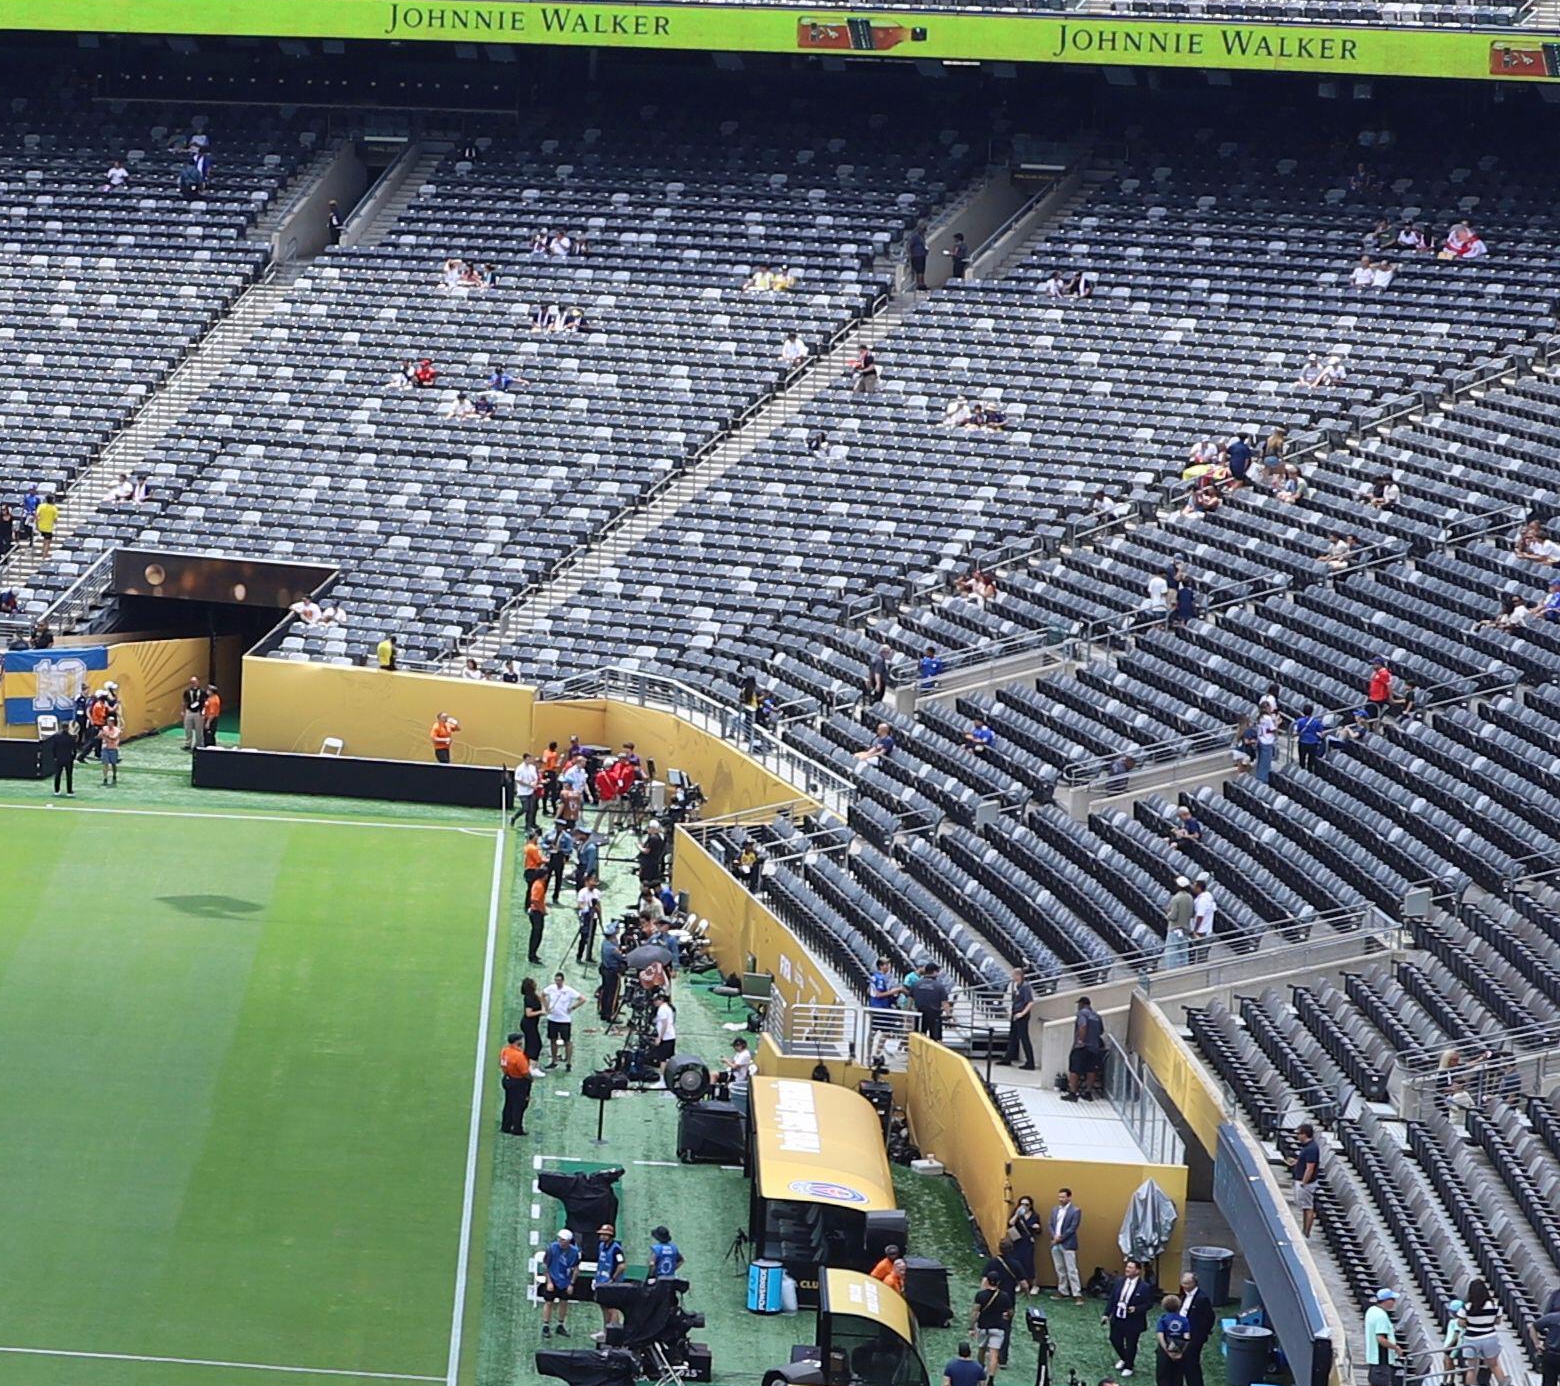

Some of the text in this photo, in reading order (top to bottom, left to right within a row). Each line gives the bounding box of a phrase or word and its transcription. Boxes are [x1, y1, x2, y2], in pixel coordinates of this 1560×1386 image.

[384, 0, 671, 37] JOHNNIE WALKER
[1054, 20, 1358, 63] JOHNNIE WALKER
[757, 1267, 768, 1311] POWERADE
